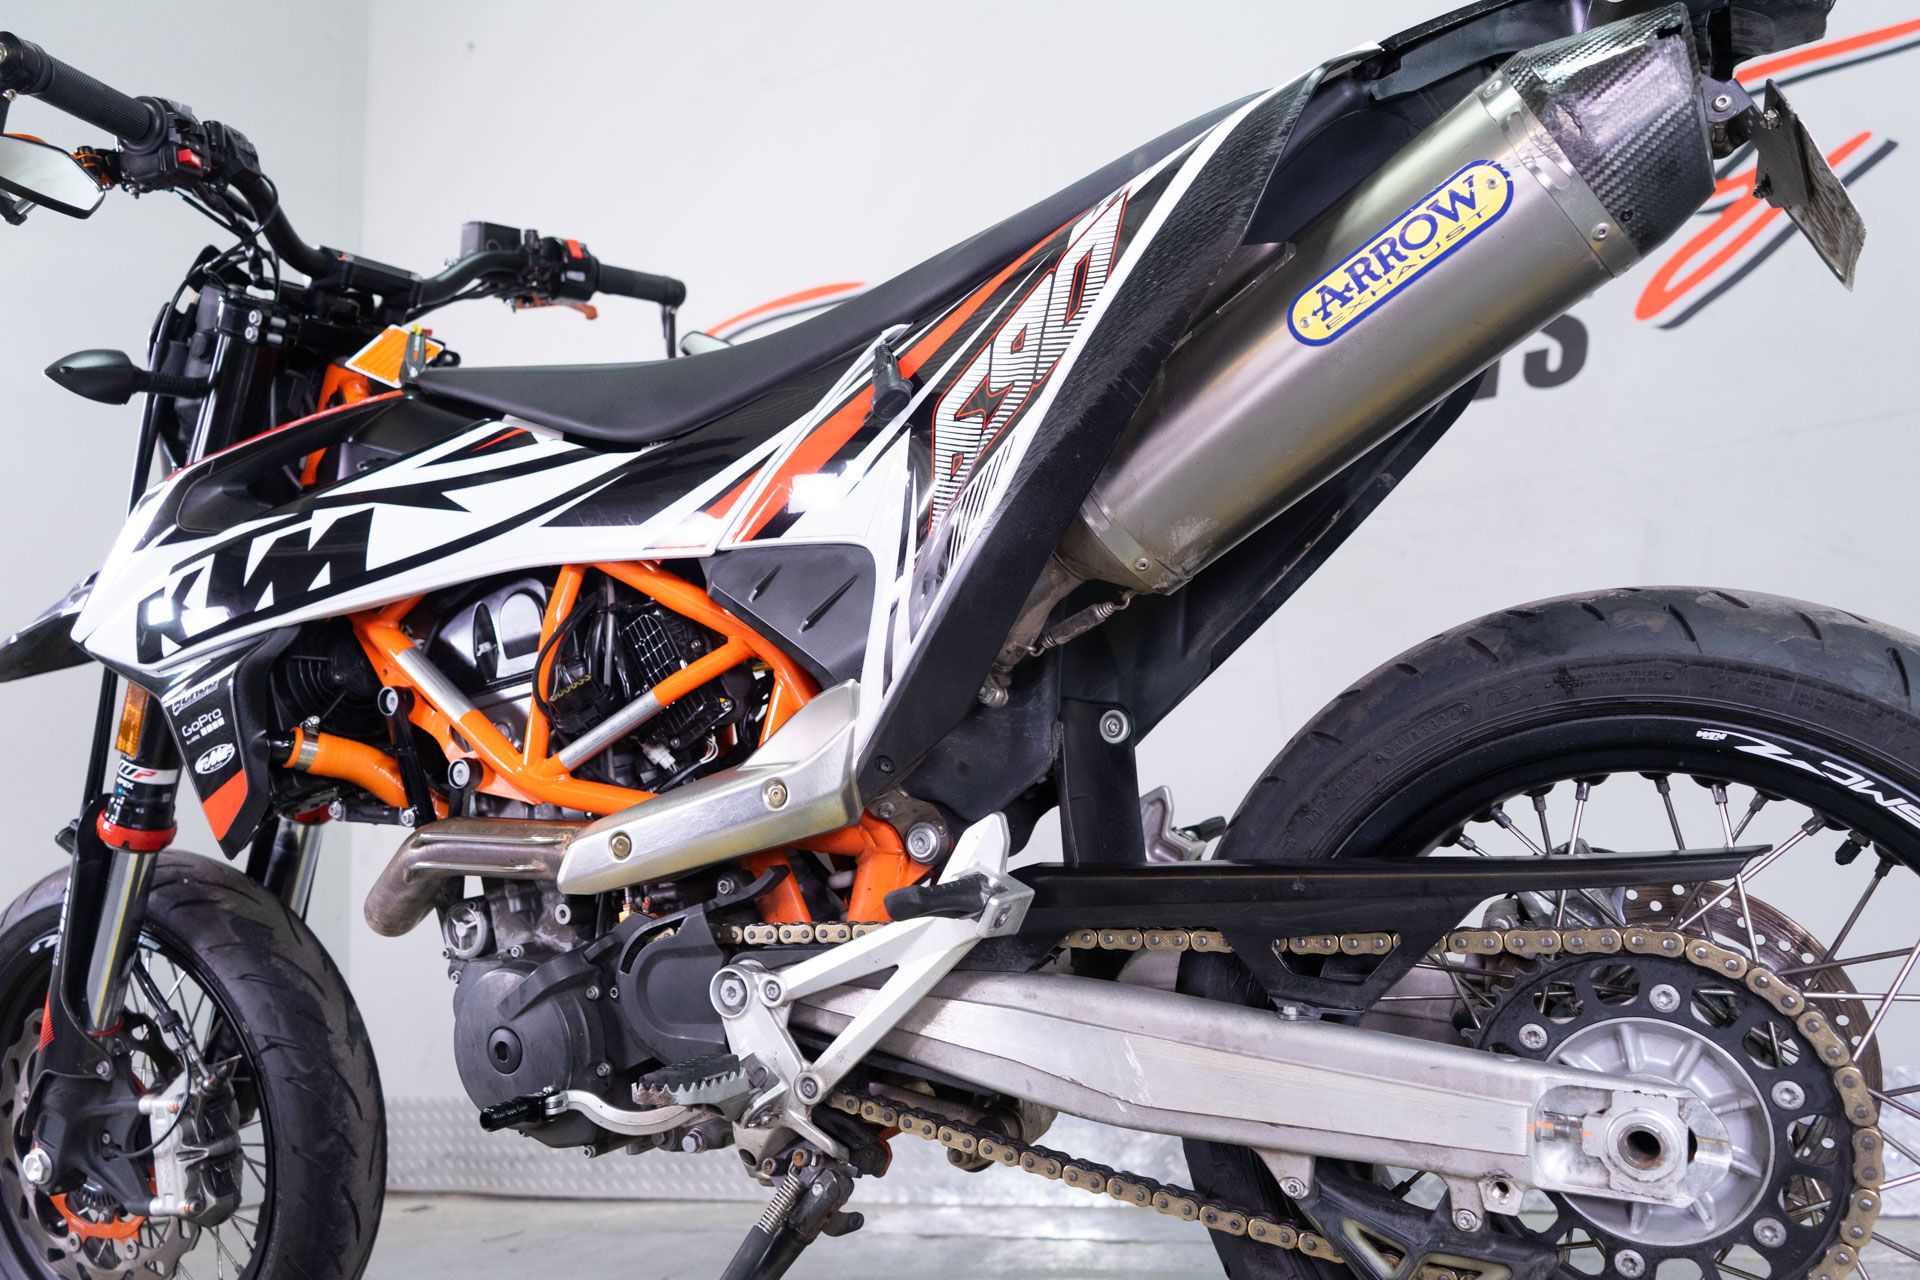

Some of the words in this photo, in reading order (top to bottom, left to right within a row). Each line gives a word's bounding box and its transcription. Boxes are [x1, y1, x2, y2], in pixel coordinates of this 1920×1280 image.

[1311, 174, 1479, 321] ARROW
[1325, 205, 1489, 330] EXHAUST
[138, 507, 375, 664] KTM
[182, 707, 223, 738] GoPro
[1696, 730, 1728, 741] KTM
